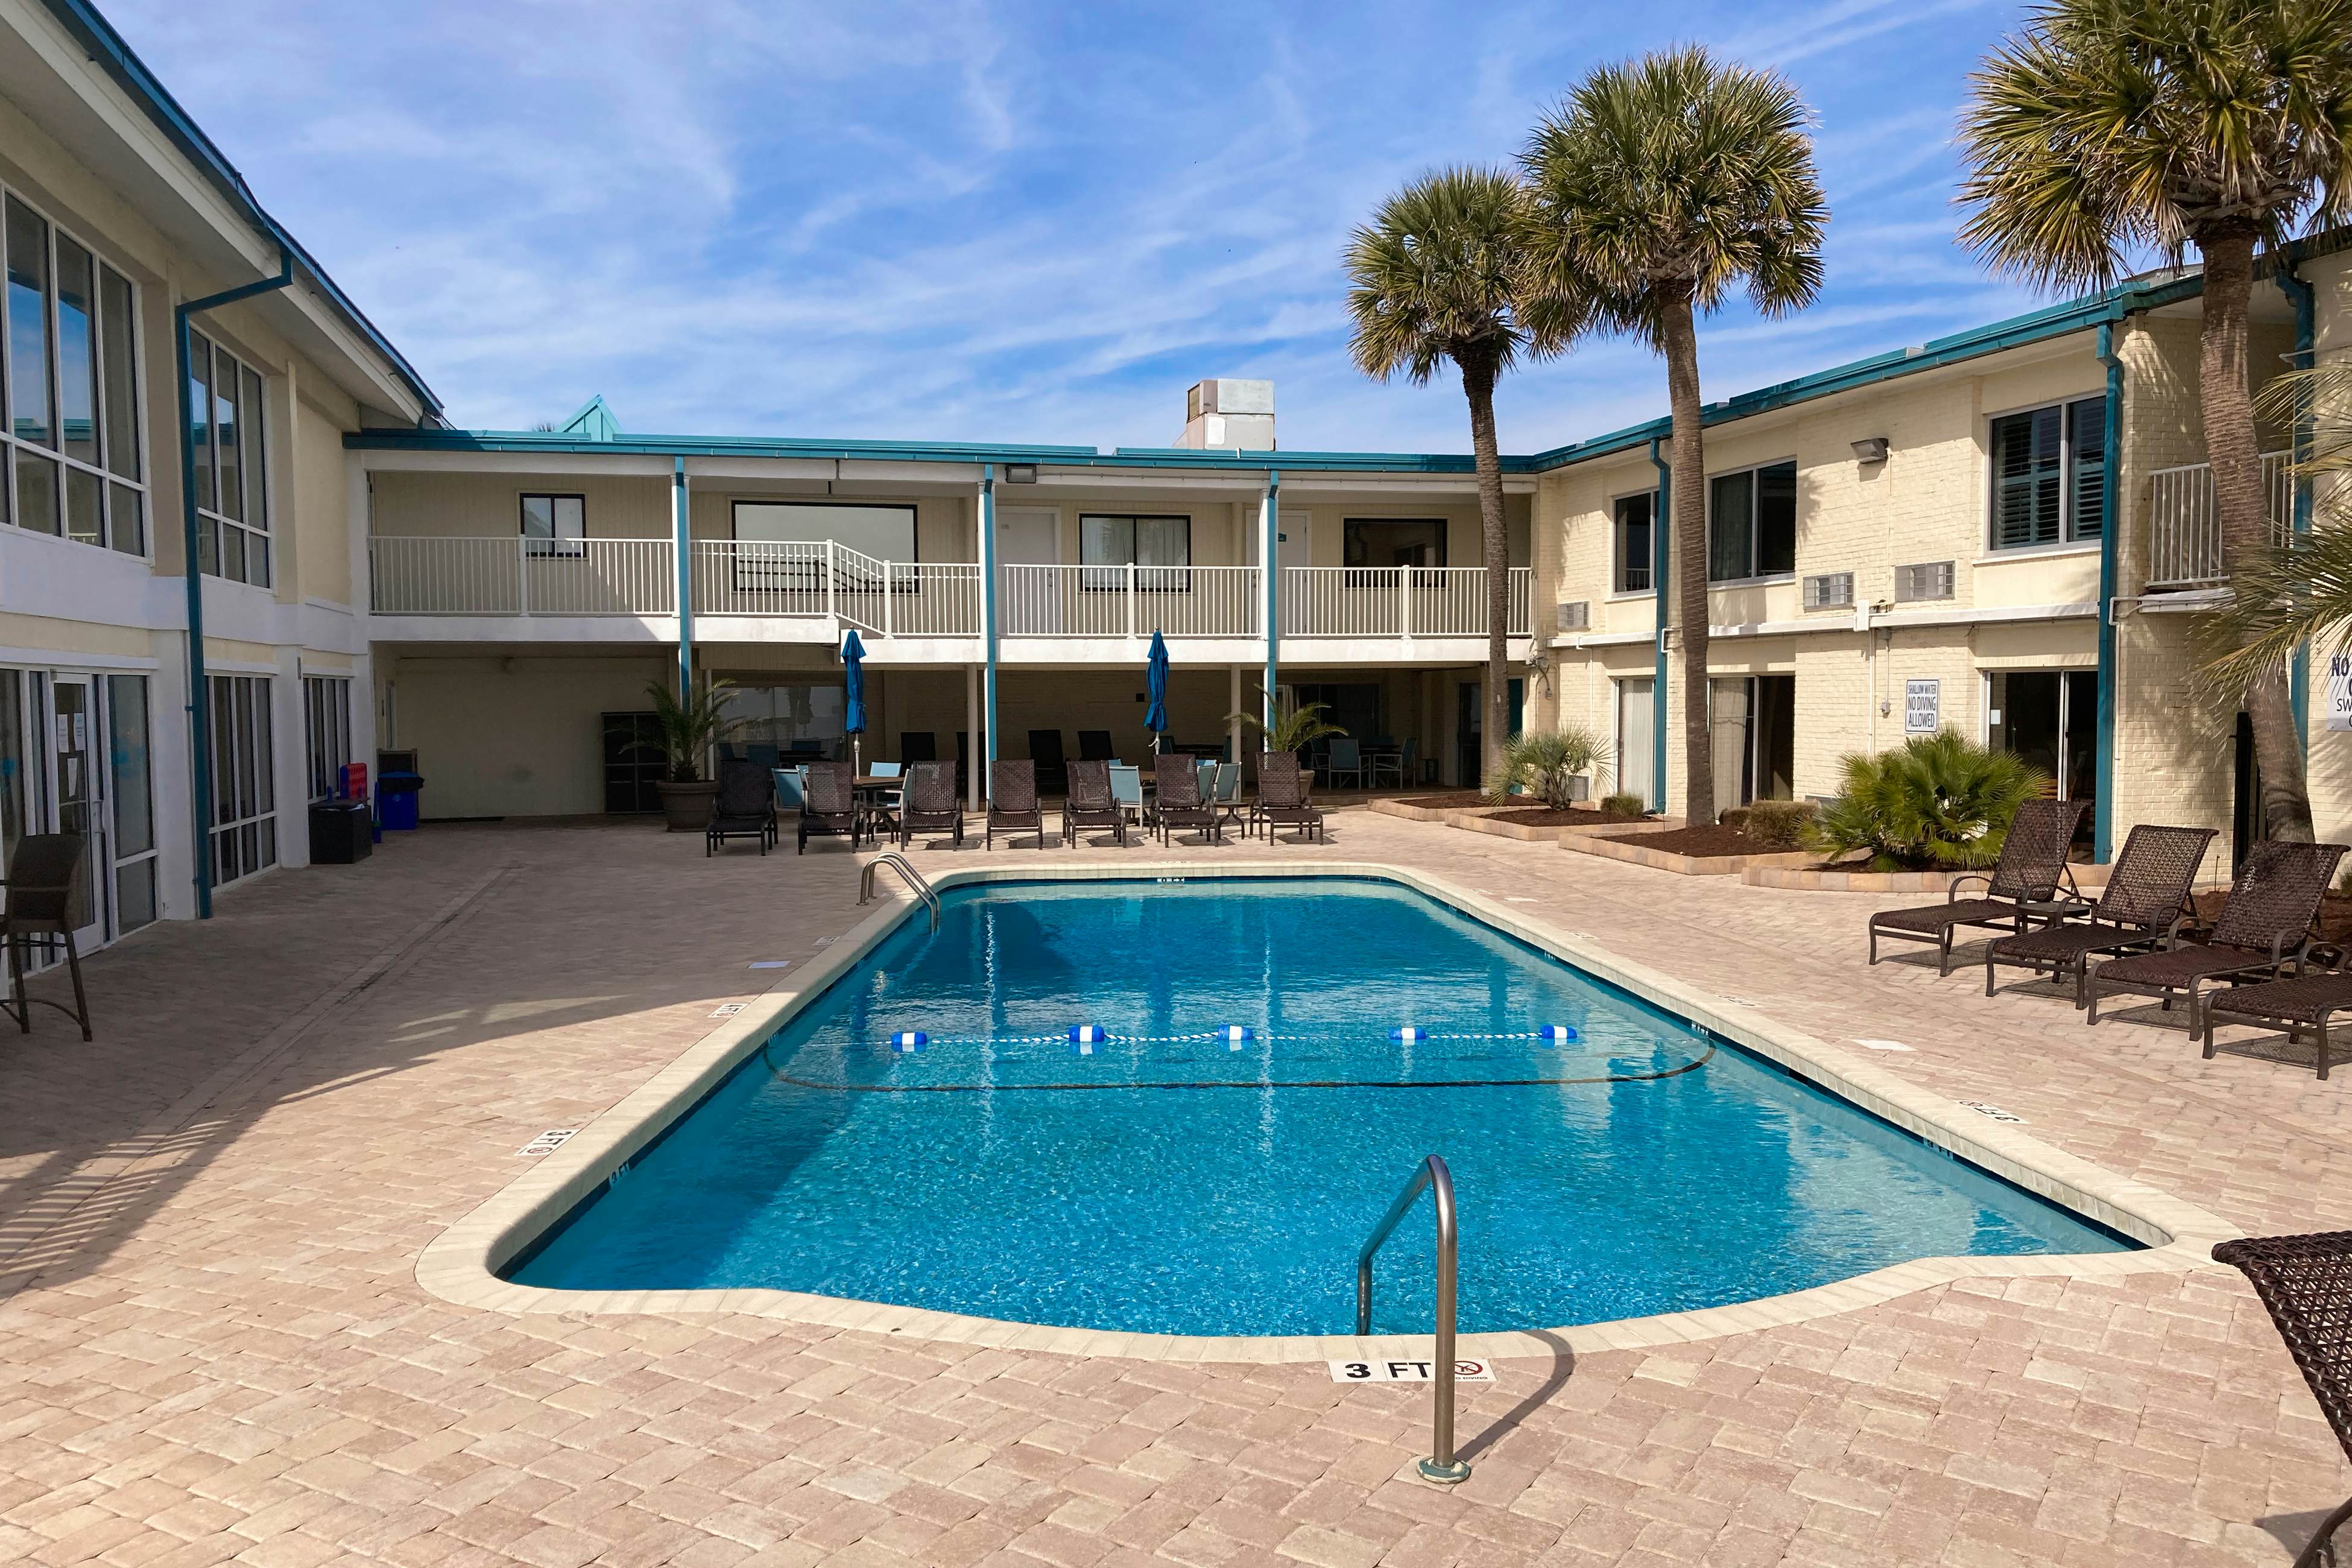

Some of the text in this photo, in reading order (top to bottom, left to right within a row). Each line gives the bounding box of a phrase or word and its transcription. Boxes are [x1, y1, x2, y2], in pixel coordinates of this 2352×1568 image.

[2331, 657, 2350, 677] NO
[1908, 684, 1936, 694] SHALLOW WATER
[1908, 697, 1936, 711] NO DIVING
[1908, 713, 1935, 727] ALLOWED
[1345, 1362, 1431, 1378] 3 FT
